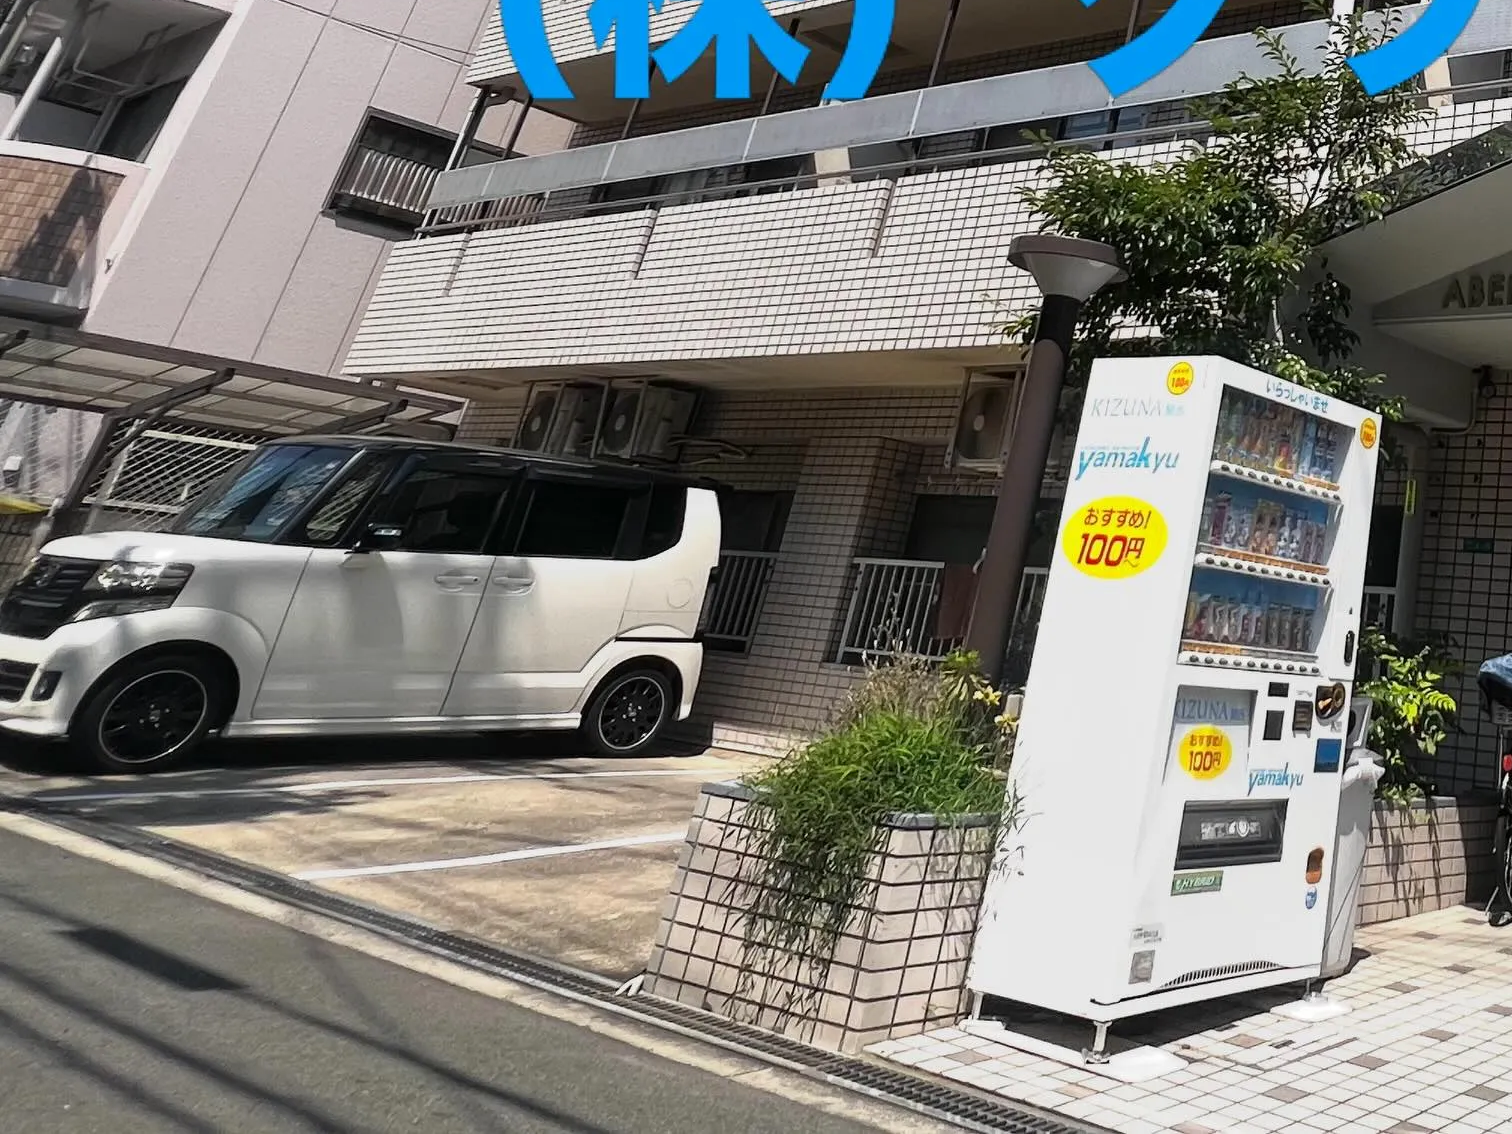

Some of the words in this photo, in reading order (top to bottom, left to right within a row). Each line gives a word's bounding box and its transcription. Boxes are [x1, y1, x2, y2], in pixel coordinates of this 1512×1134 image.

[1090, 397, 1161, 417] KIZUNA
[1075, 436, 1180, 481] yamakyu
[1247, 761, 1304, 797] yamakyu
